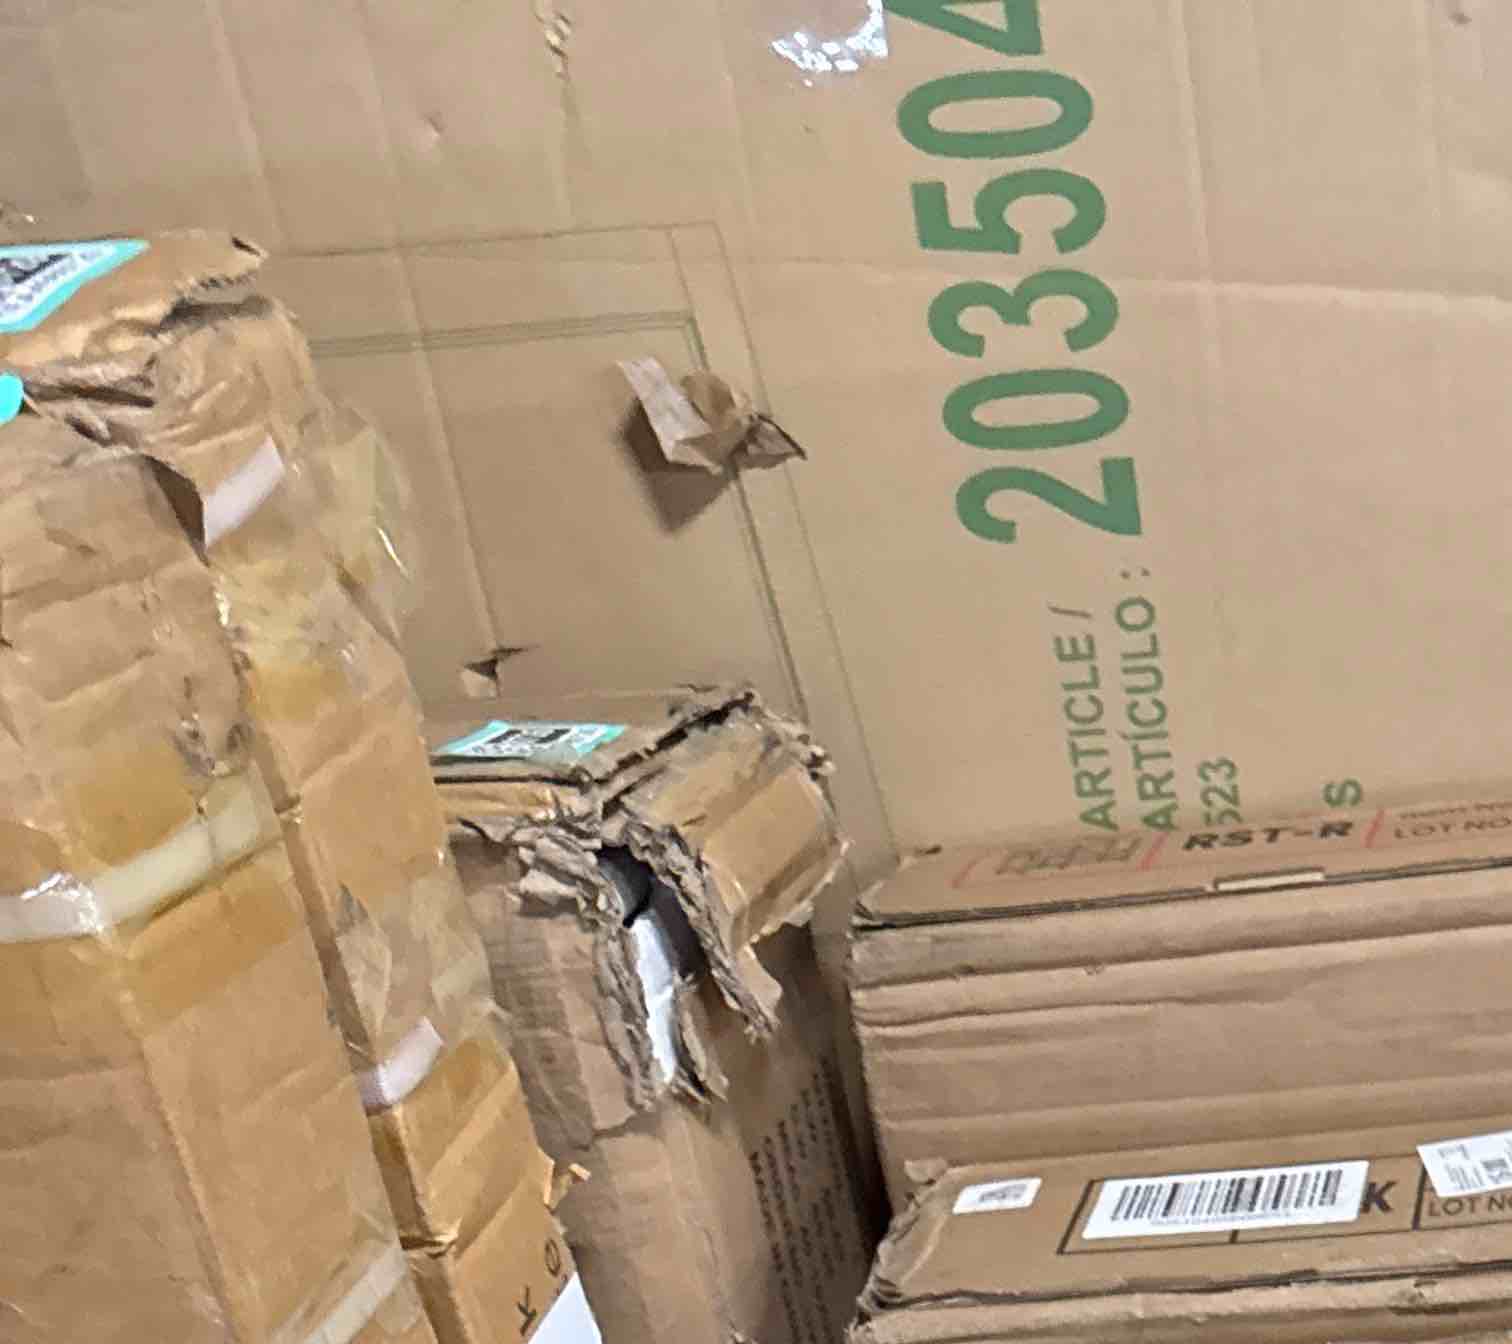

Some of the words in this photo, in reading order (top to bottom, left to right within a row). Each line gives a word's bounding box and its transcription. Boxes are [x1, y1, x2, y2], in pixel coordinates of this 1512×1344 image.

[1053, 626, 1122, 831] ARTICLE
[1114, 596, 1179, 832] ARTÍCULO
[1181, 821, 1353, 852] RST-R
[1427, 1196, 1480, 1218] LOT
